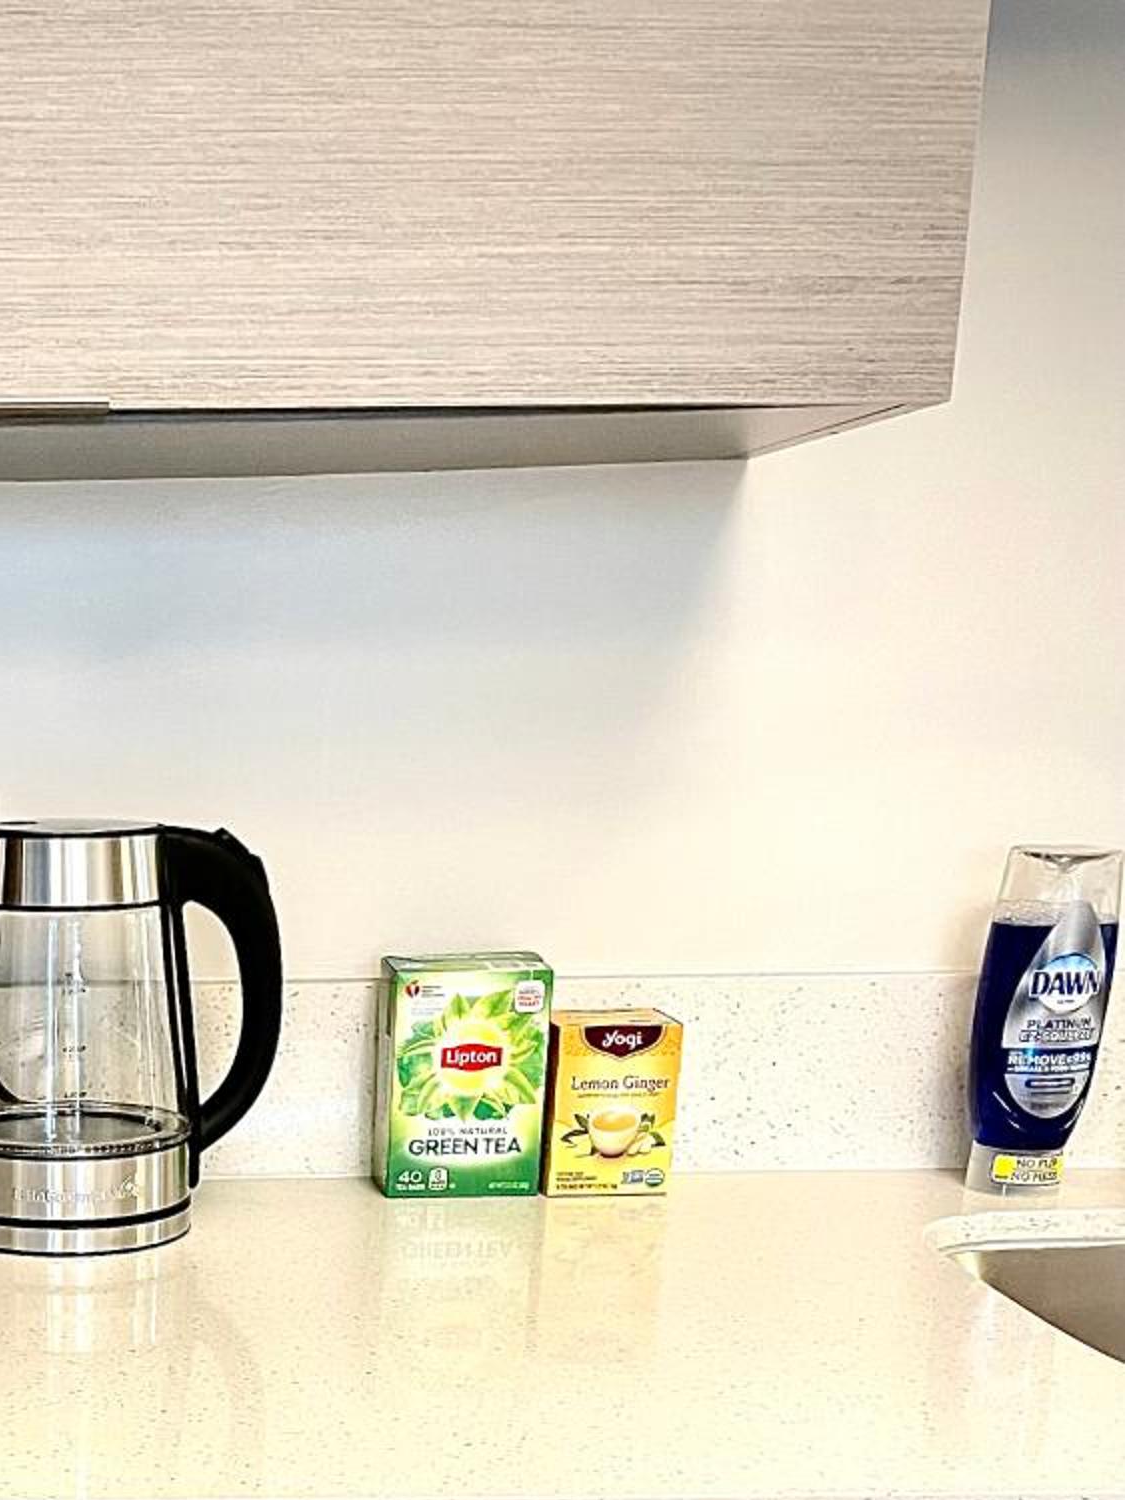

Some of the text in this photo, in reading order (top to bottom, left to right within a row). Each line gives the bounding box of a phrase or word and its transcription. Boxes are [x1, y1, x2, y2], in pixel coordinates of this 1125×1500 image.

[1030, 969, 1100, 997] DAWN
[446, 1050, 498, 1069] Lipton
[571, 1075, 670, 1093] Lemon Ginger
[459, 1127, 508, 1135] NATURAL
[409, 1137, 522, 1156] GREEN TEA
[398, 1170, 422, 1183] 40
